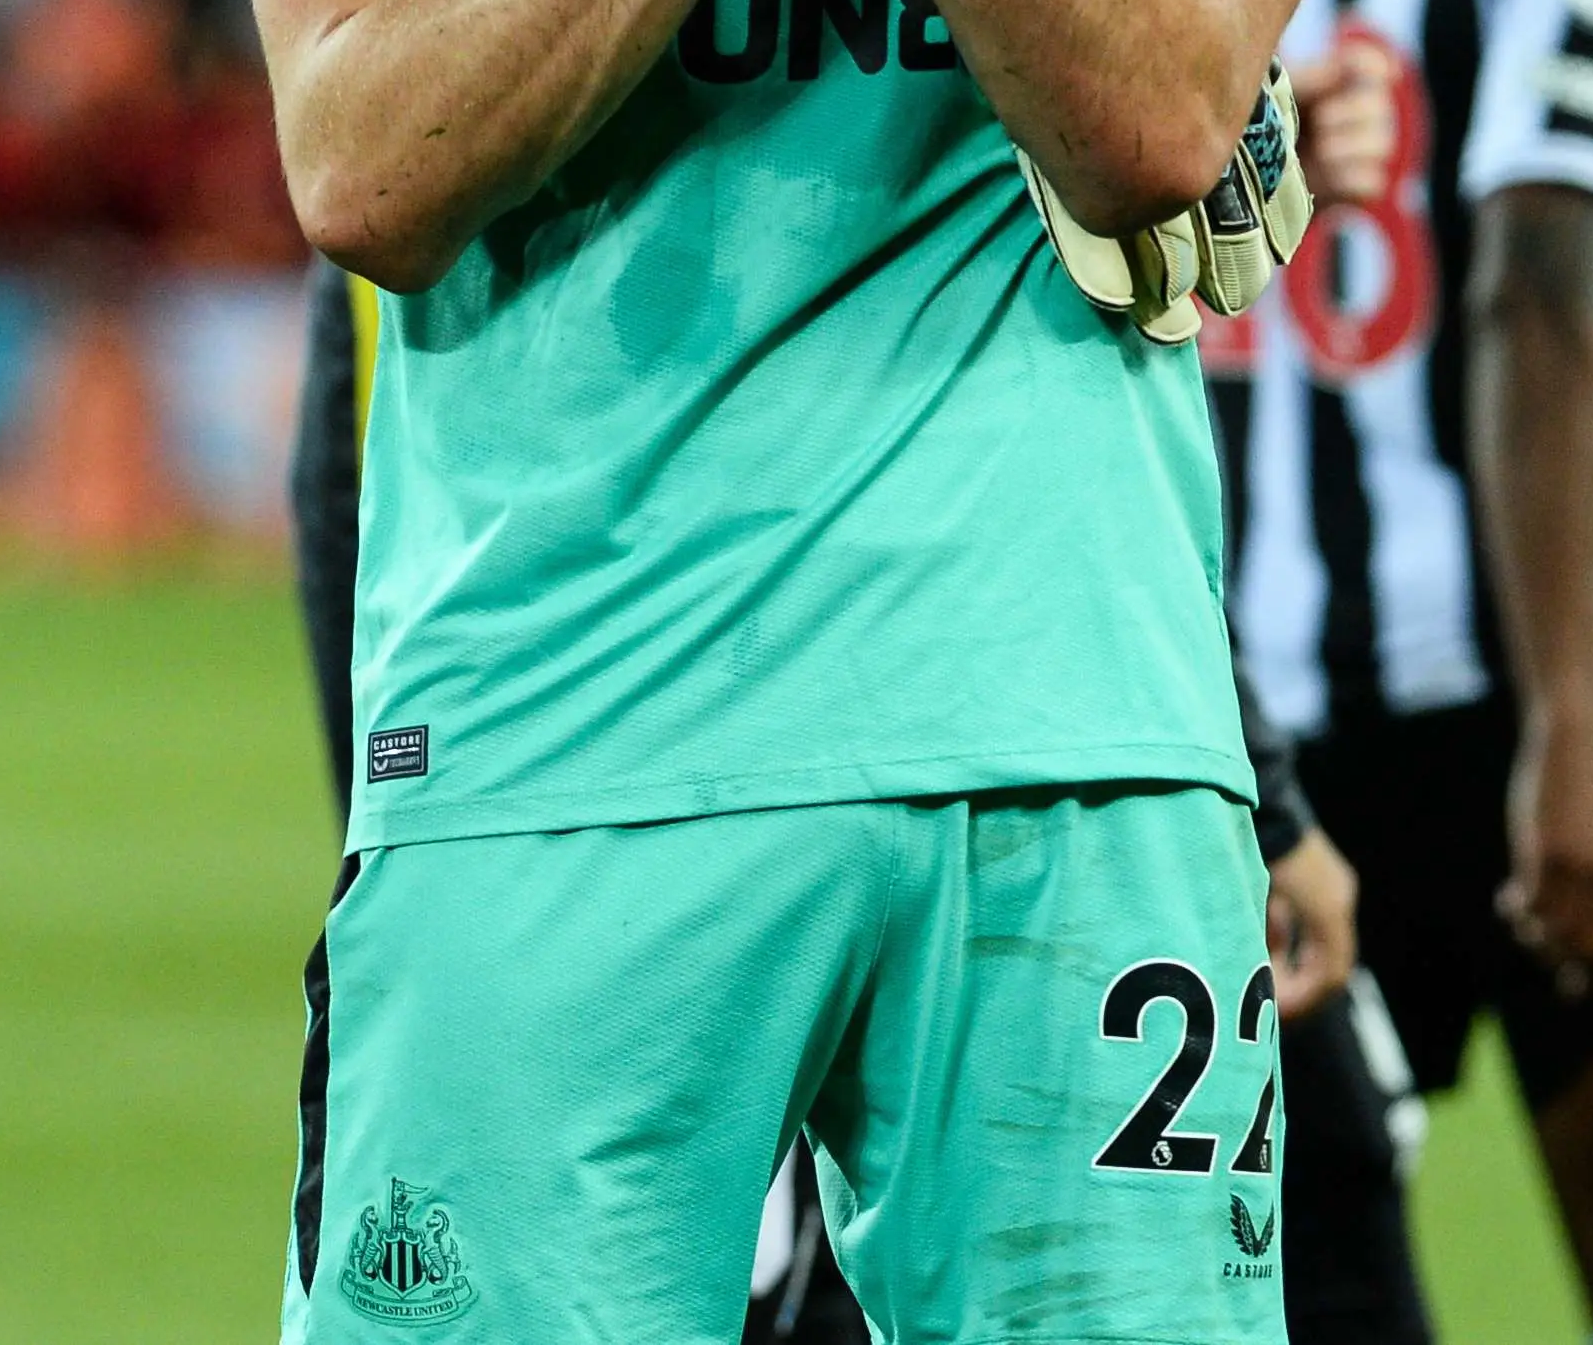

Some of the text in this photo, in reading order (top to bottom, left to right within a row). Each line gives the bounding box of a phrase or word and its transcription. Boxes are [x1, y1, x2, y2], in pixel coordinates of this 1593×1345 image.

[373, 734, 420, 751] CASTORE
[1090, 957, 1274, 1176] 22
[357, 1296, 453, 1317] NEWCASTLE UNITED
